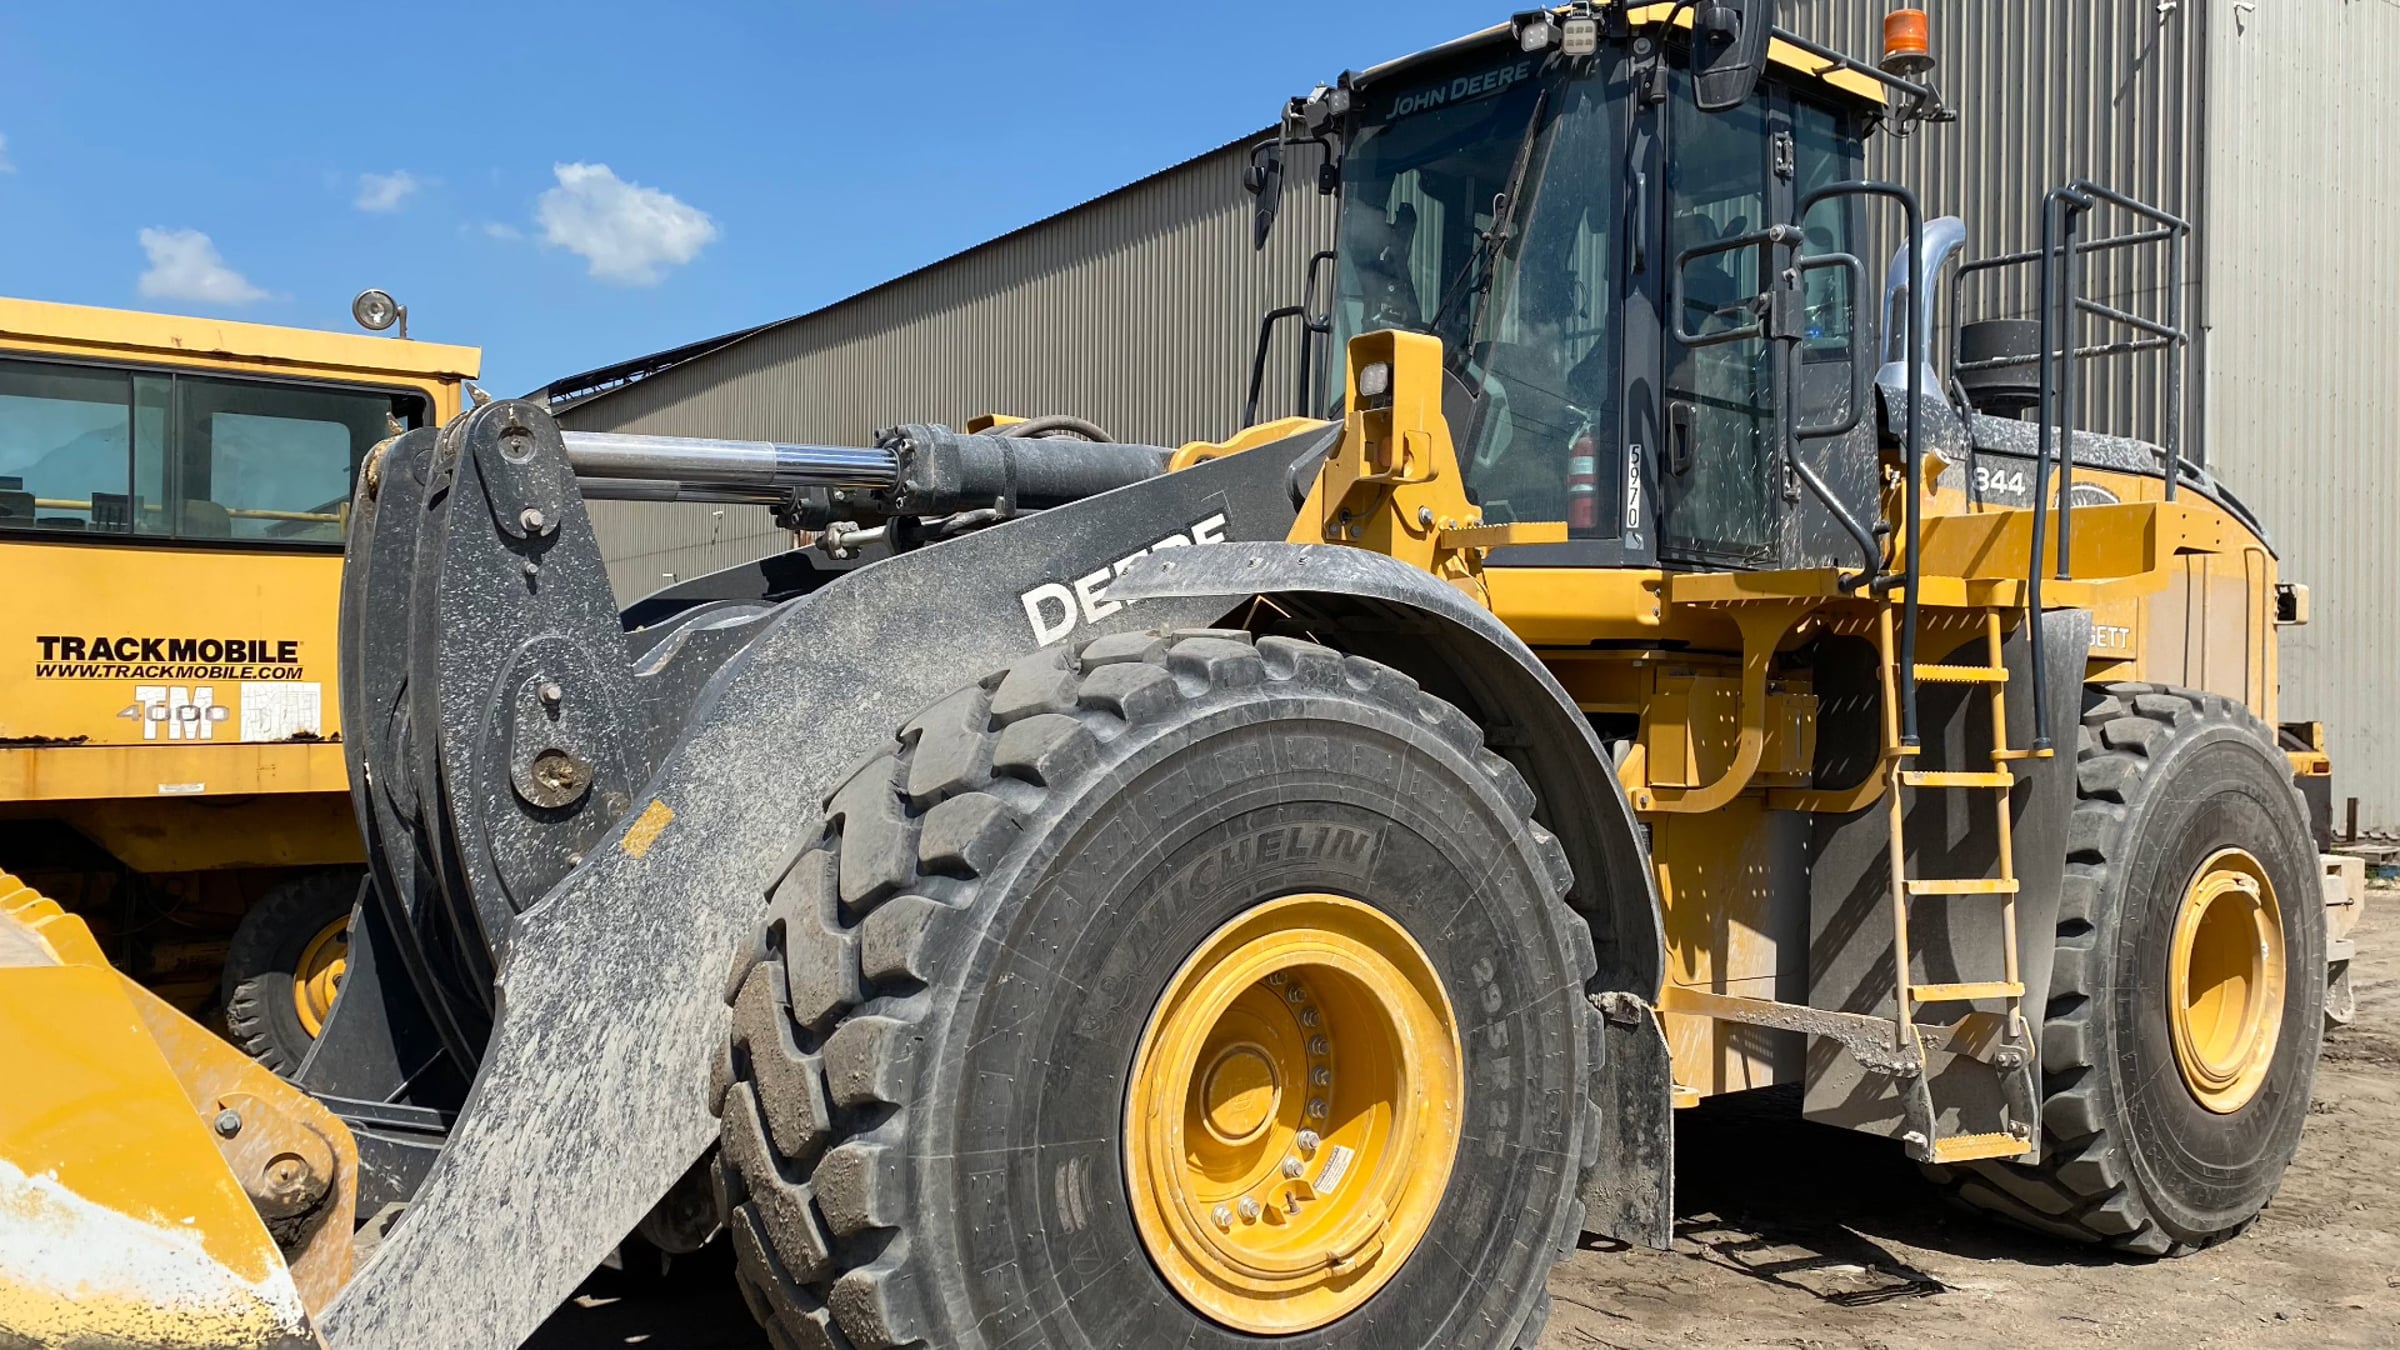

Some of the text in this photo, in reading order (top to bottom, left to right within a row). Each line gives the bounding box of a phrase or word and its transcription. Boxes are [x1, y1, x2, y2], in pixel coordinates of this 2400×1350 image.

[1385, 60, 1531, 120] JOHN DEERE
[1628, 445, 1640, 527] 5970
[1972, 466, 2026, 496] 844
[36, 636, 298, 663] TRACKMOBILE
[36, 665, 303, 679] WWW.TRACKMOBILE.COM
[1128, 826, 1374, 966] MICHELIN
